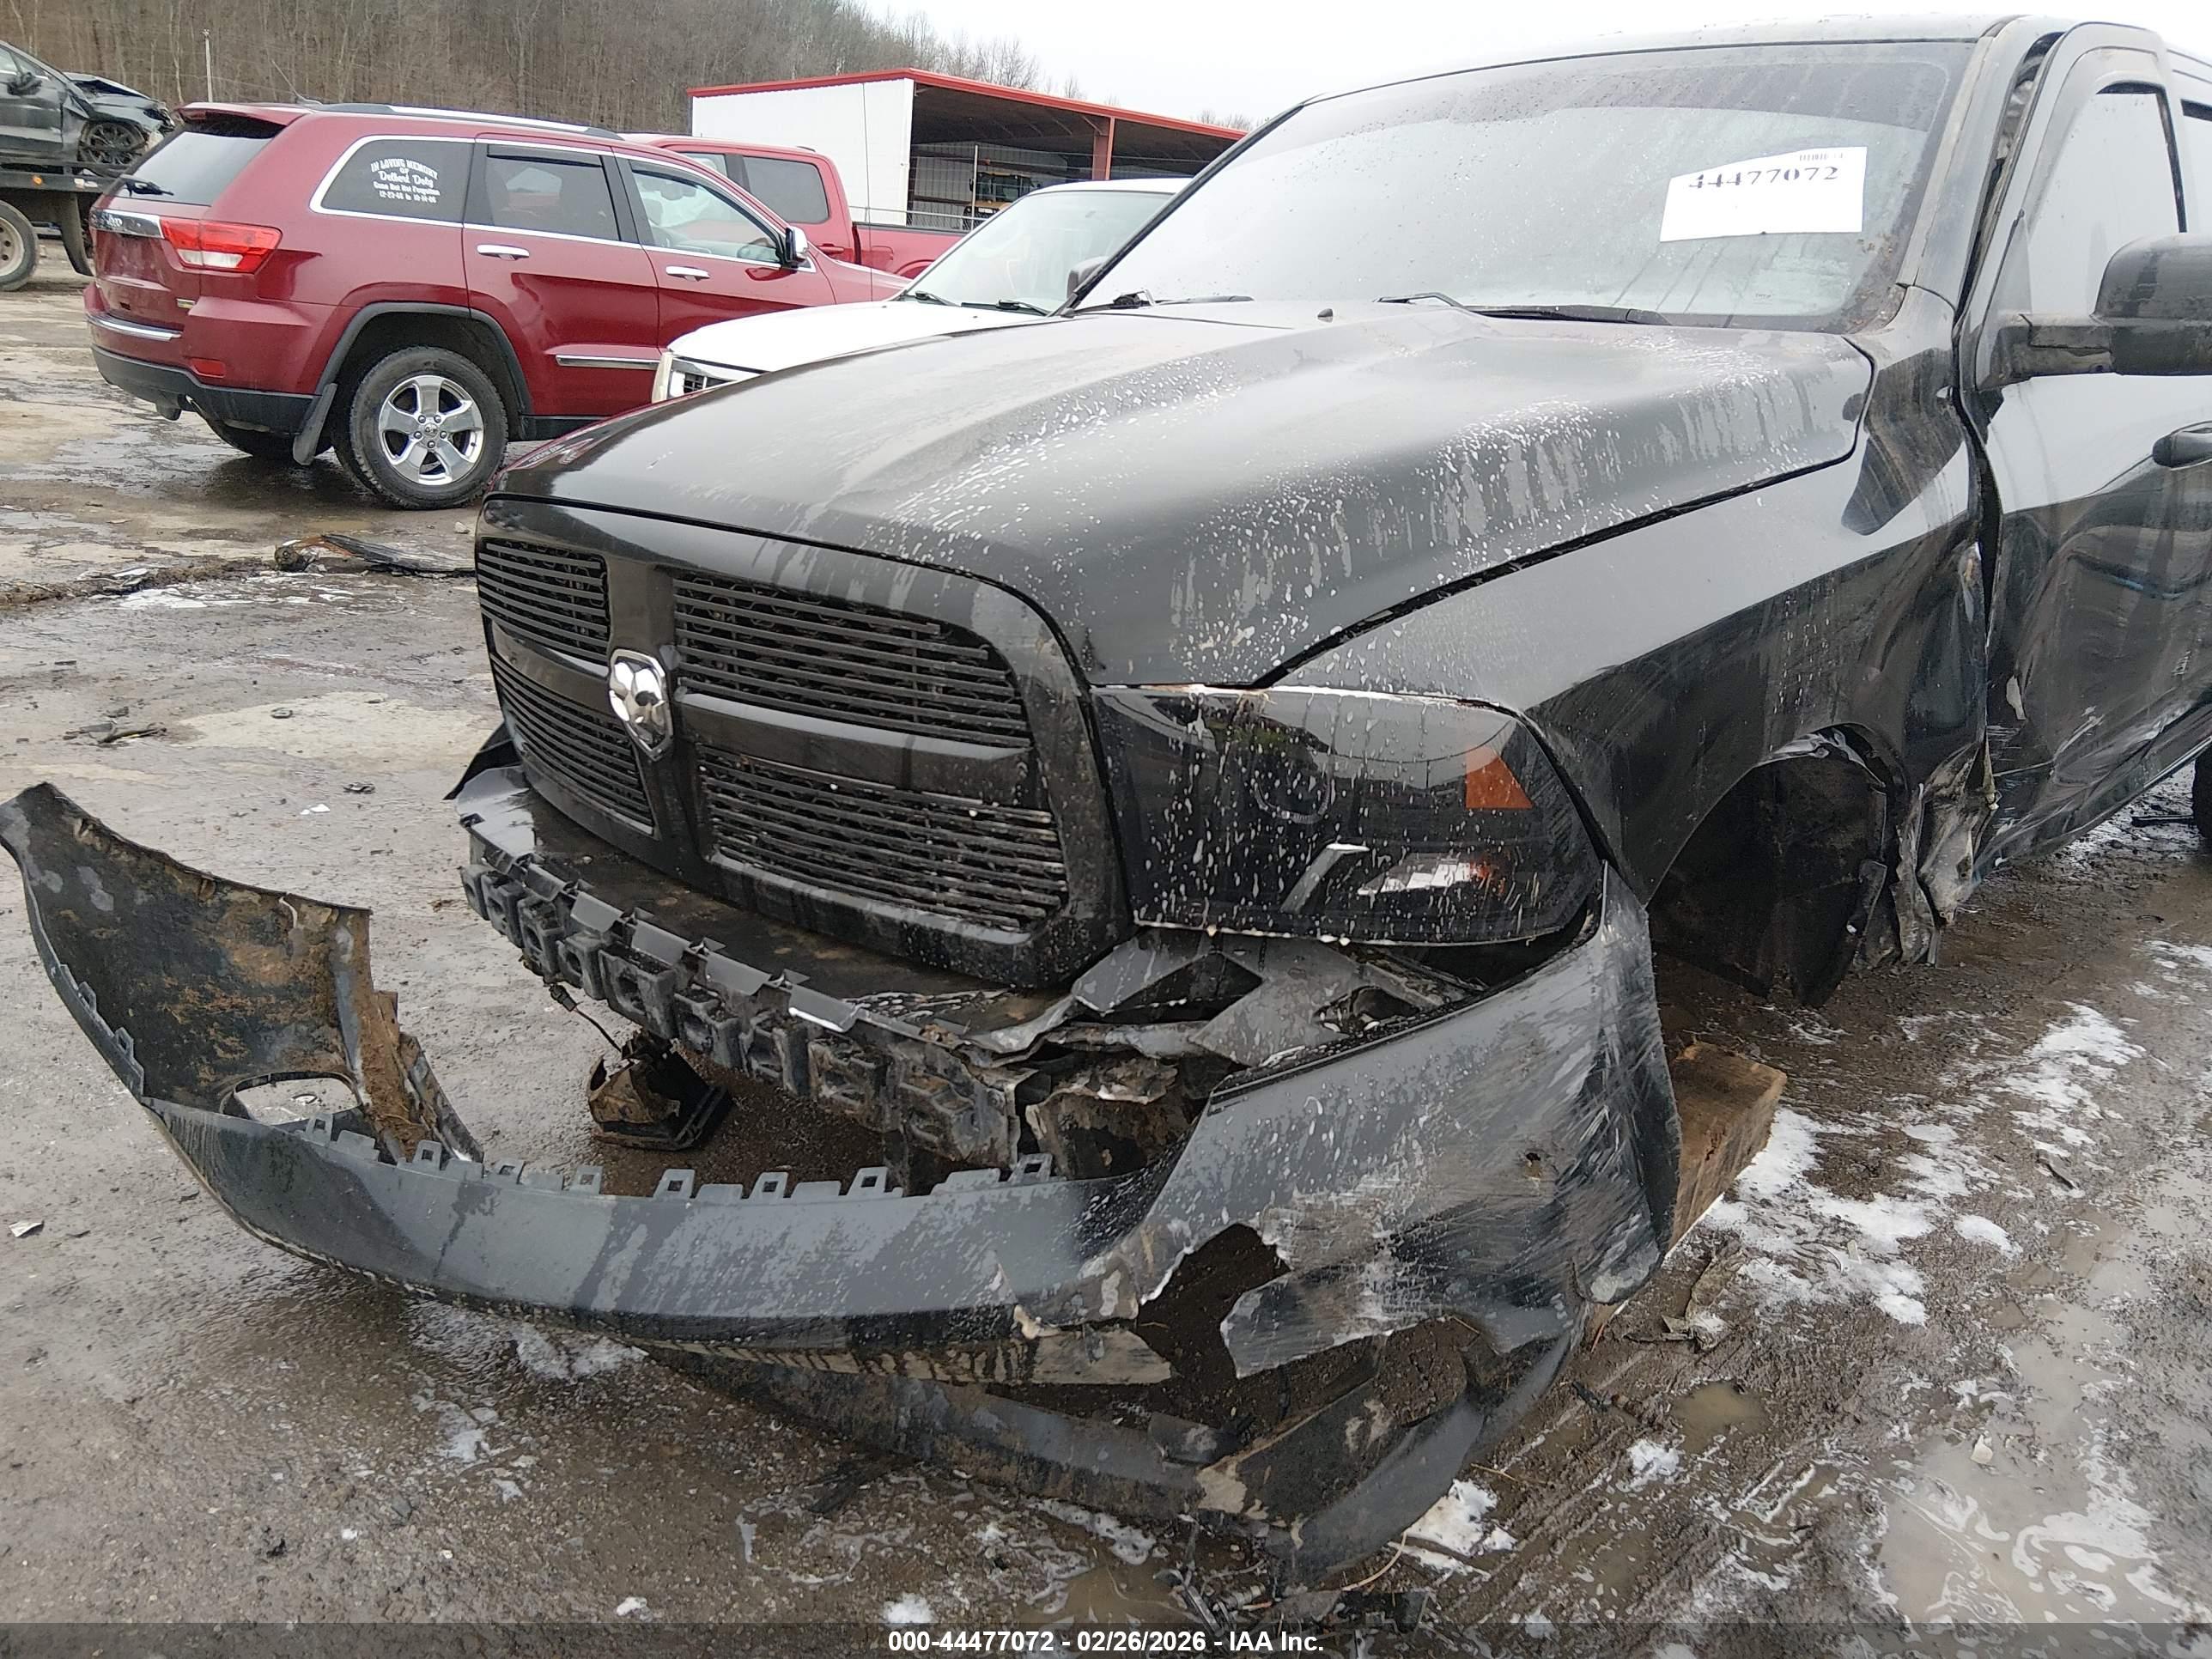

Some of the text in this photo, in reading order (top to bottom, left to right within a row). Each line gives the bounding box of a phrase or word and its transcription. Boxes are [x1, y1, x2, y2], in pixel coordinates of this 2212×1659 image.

[380, 159, 405, 169] LOVING
[406, 160, 438, 179] MEMORY
[1689, 167, 1838, 189] 44477072
